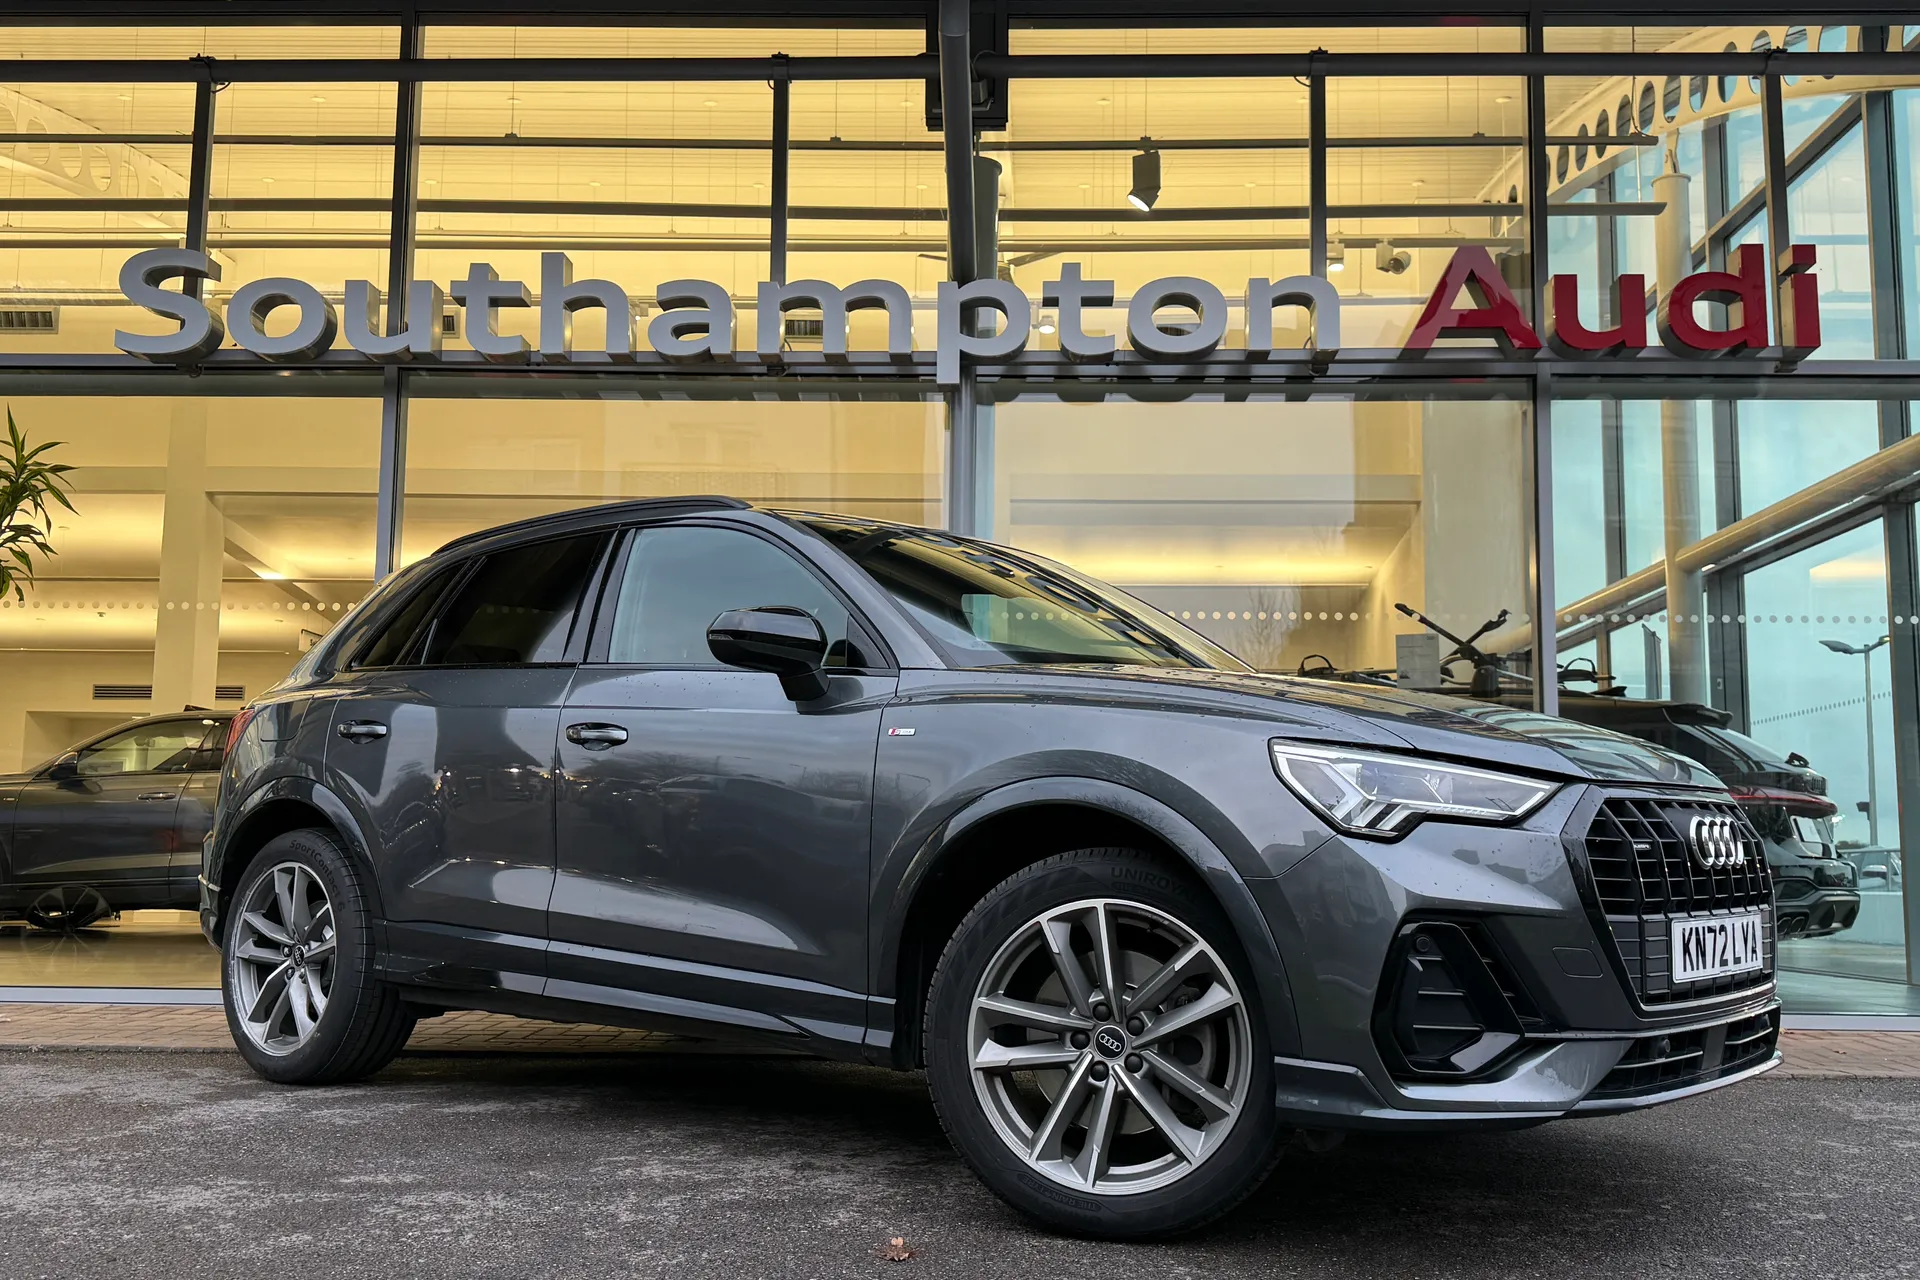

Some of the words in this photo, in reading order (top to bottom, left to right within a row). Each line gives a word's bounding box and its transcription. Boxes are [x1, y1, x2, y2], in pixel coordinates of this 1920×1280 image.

[114, 247, 1341, 386] Southampton
[1402, 244, 1821, 355] Audi
[289, 840, 339, 897] SportContact
[338, 903, 345, 912] 6
[1112, 866, 1197, 903] UNIROYAL
[1682, 924, 1728, 972] KN72
[1732, 920, 1758, 965] LYA
[1050, 1192, 1076, 1206] RAIN
